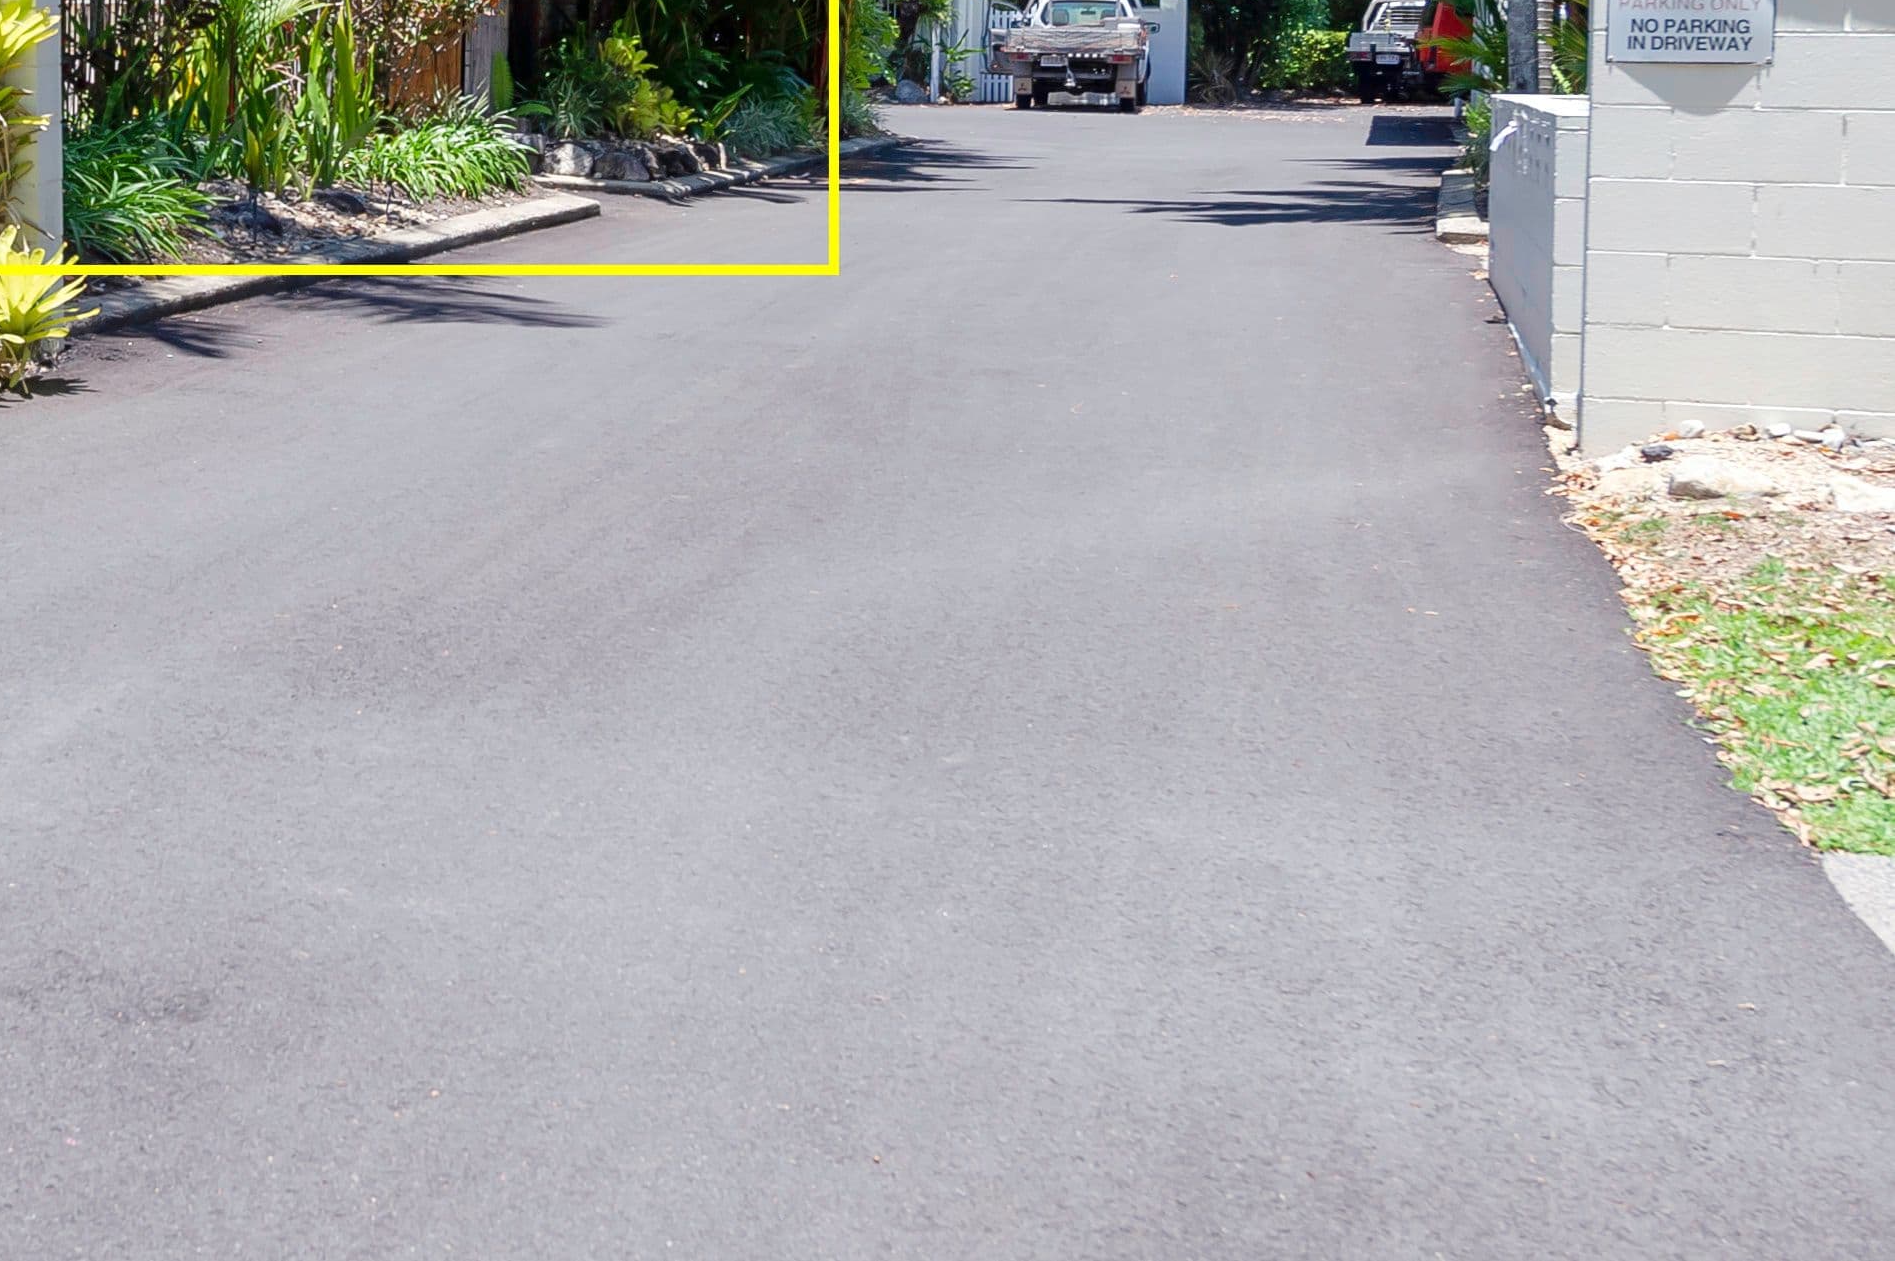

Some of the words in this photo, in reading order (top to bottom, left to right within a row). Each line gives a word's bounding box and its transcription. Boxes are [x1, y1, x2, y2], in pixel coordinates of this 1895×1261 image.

[1630, 18, 1659, 33] NO
[1664, 18, 1751, 34] PARKING
[1627, 36, 1646, 50] IN
[1651, 36, 1755, 52] DRIVEWAY
